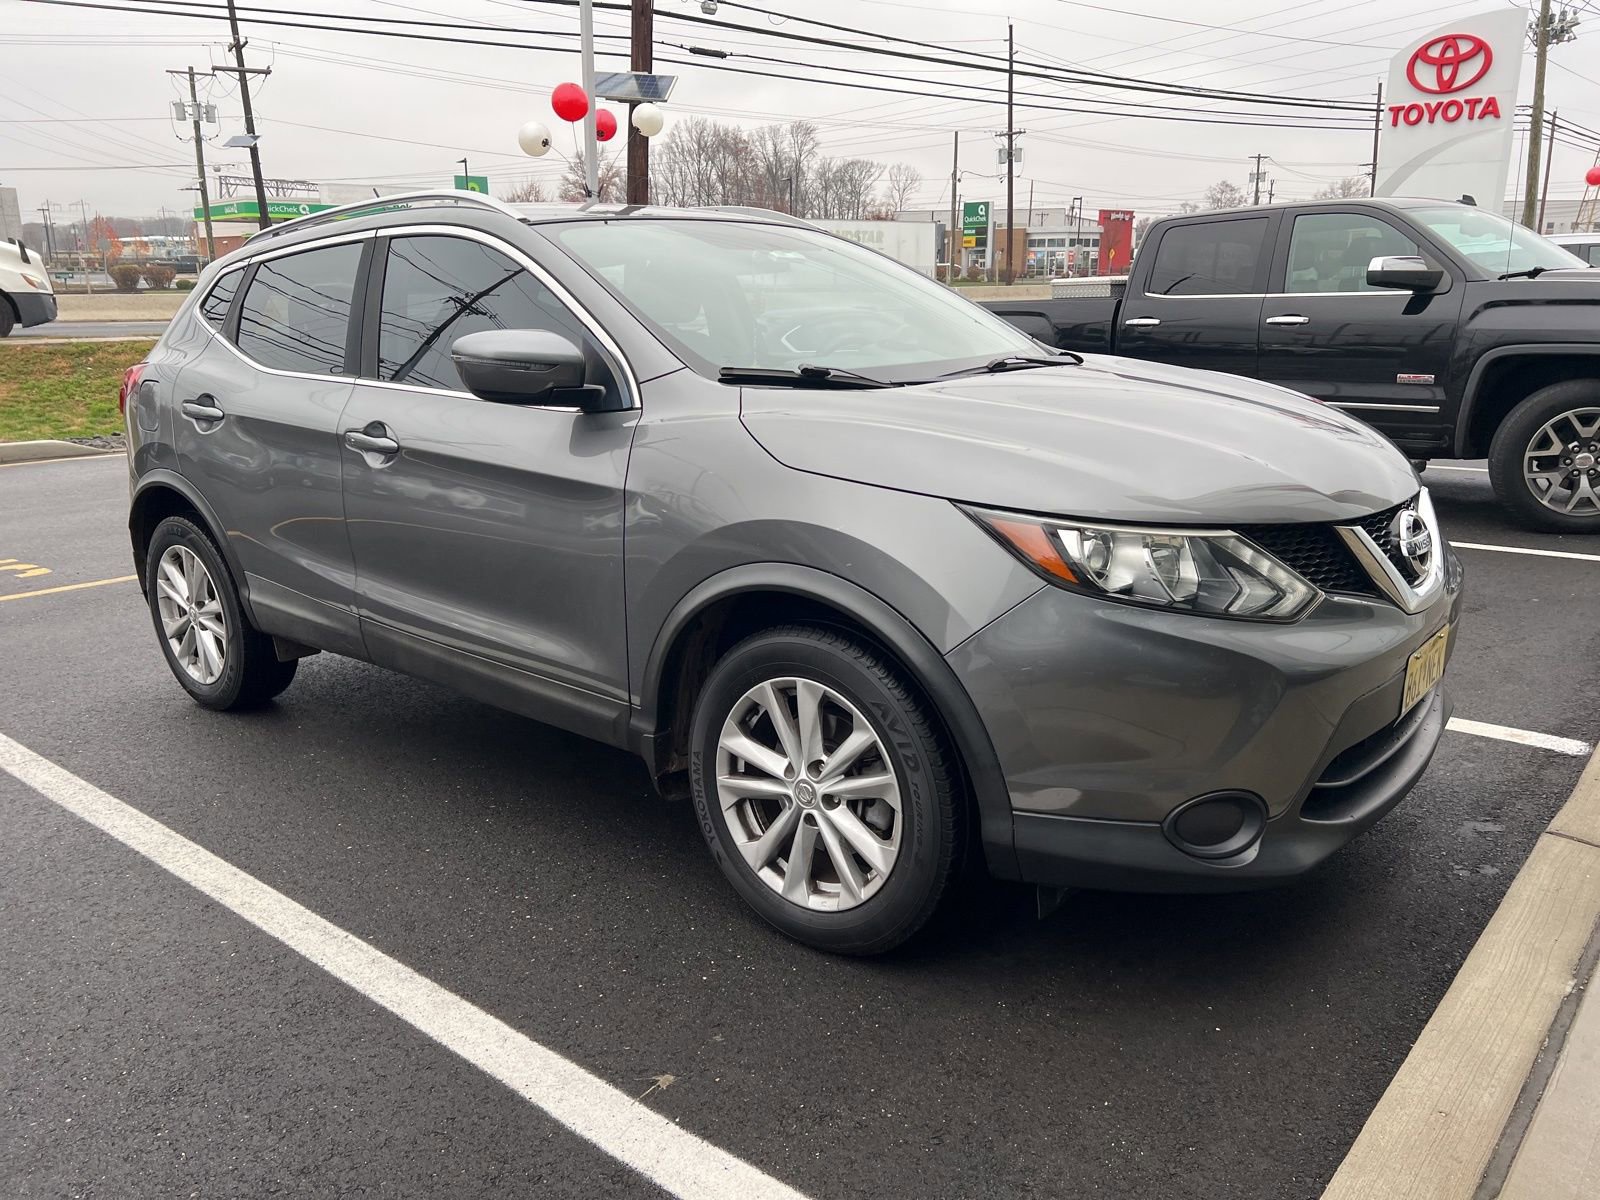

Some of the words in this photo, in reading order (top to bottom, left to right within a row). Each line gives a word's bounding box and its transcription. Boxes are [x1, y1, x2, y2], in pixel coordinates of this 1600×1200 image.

[1388, 97, 1501, 127] TOYOTA
[267, 205, 298, 213] ickChek
[869, 701, 921, 772] AVID
[692, 751, 716, 844] YOKOHAMA
